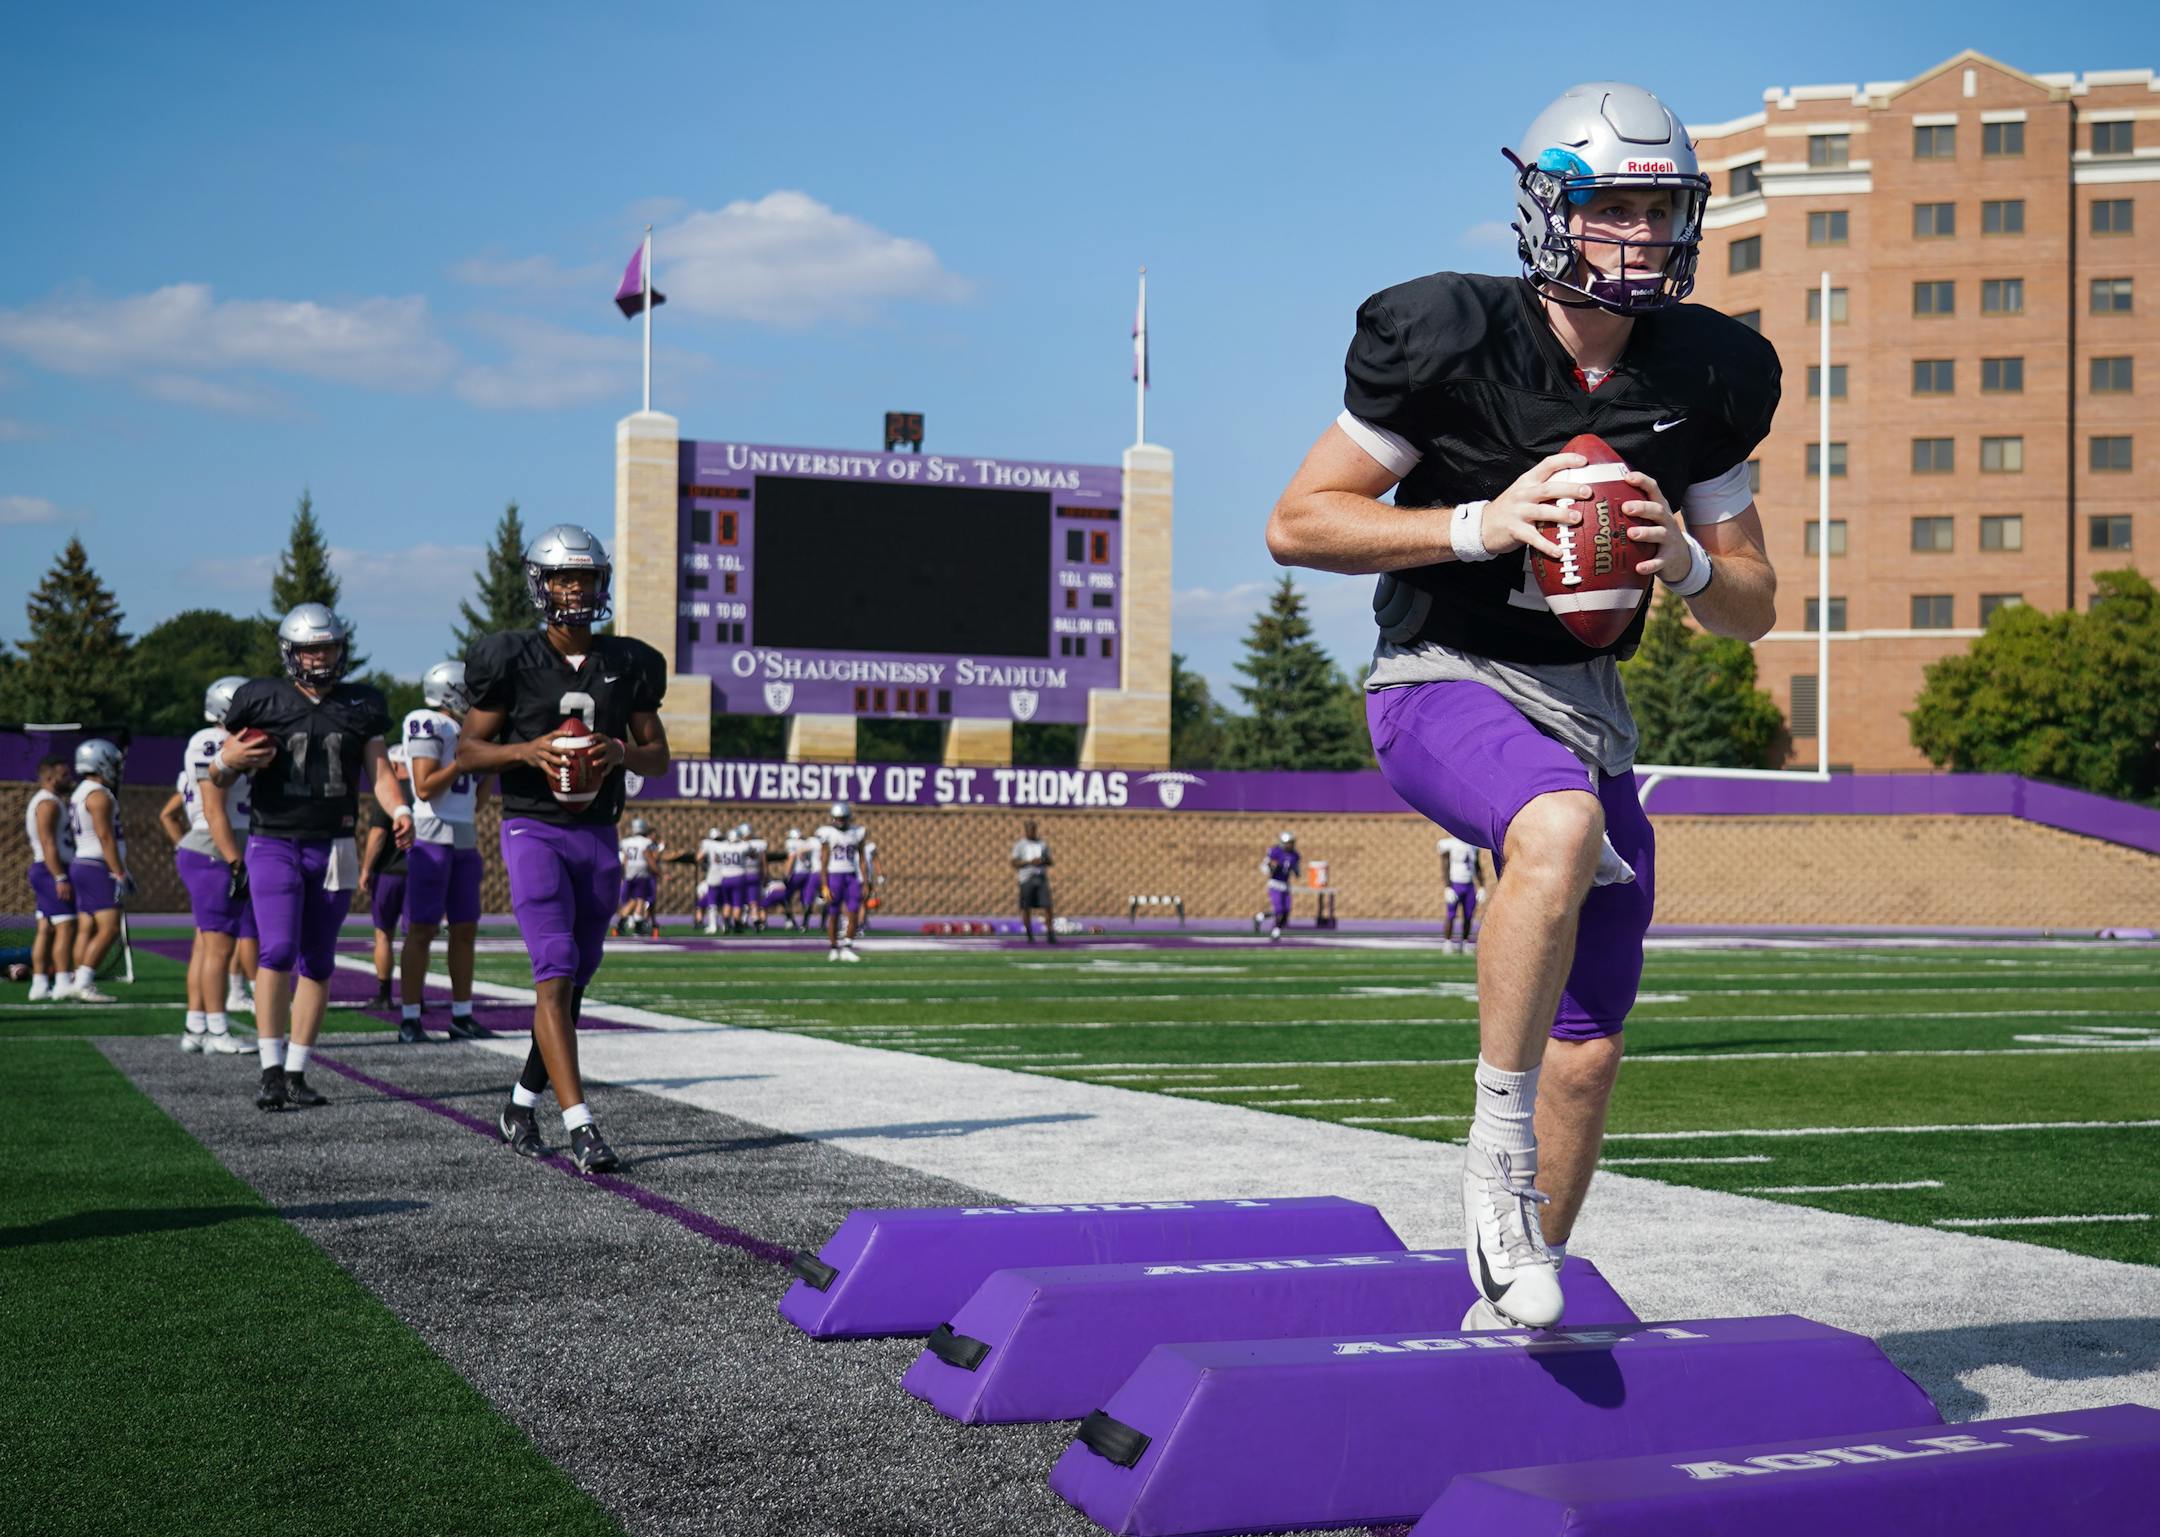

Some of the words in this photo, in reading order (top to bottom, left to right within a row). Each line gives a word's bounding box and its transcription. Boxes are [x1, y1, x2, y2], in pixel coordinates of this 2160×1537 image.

[1628, 161, 1673, 173] Riddell
[726, 444, 883, 478] UNIVERSITY
[887, 458, 922, 480] OF
[926, 456, 967, 483] ST.
[972, 459, 1080, 490] THOMAS
[1594, 497, 1613, 576] Wilson
[731, 650, 945, 684] O'SHAUGHNESSY
[955, 657, 1068, 689] STADIUM
[284, 732, 347, 797] 11
[677, 761, 878, 801] UNIVERSITY
[885, 767, 926, 803] OF
[934, 767, 985, 804] ST.
[993, 769, 1129, 807] THOMAS
[961, 1202, 1195, 1215] AGILE
[1143, 1256, 1395, 1277] AGILE
[1403, 1253, 1456, 1261] 1
[1333, 1331, 1635, 1356] AGILE
[1646, 1327, 1710, 1340] 1
[1671, 1434, 2014, 1480] AGILE
[2000, 1427, 2090, 1443] 1
